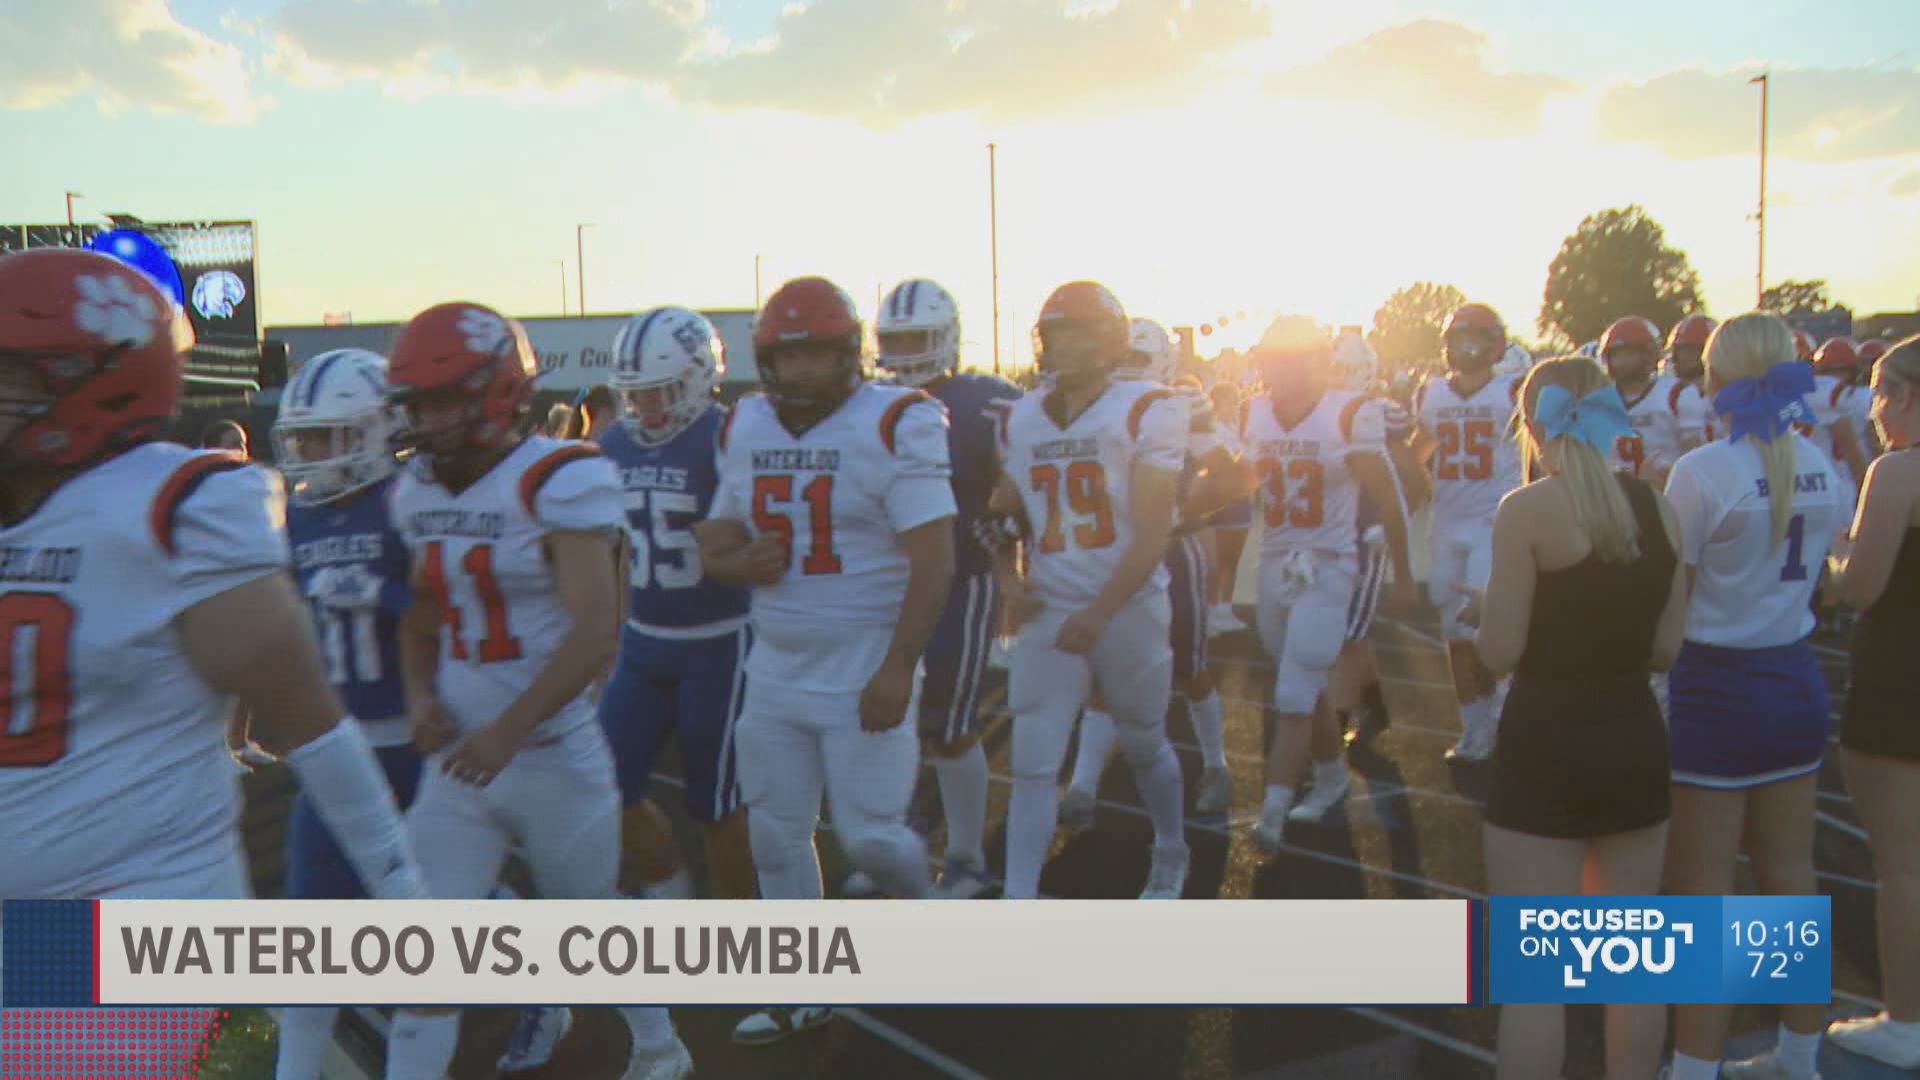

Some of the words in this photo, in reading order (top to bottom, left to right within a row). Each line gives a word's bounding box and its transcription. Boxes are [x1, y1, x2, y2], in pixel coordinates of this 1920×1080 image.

[752, 449, 841, 471] WATERLOO
[1436, 420, 1496, 480] 25
[1029, 461, 1116, 555] 79
[1755, 473, 1828, 498] BANT
[623, 489, 704, 589] 55
[752, 474, 842, 576] 51
[1779, 513, 1808, 582] 1
